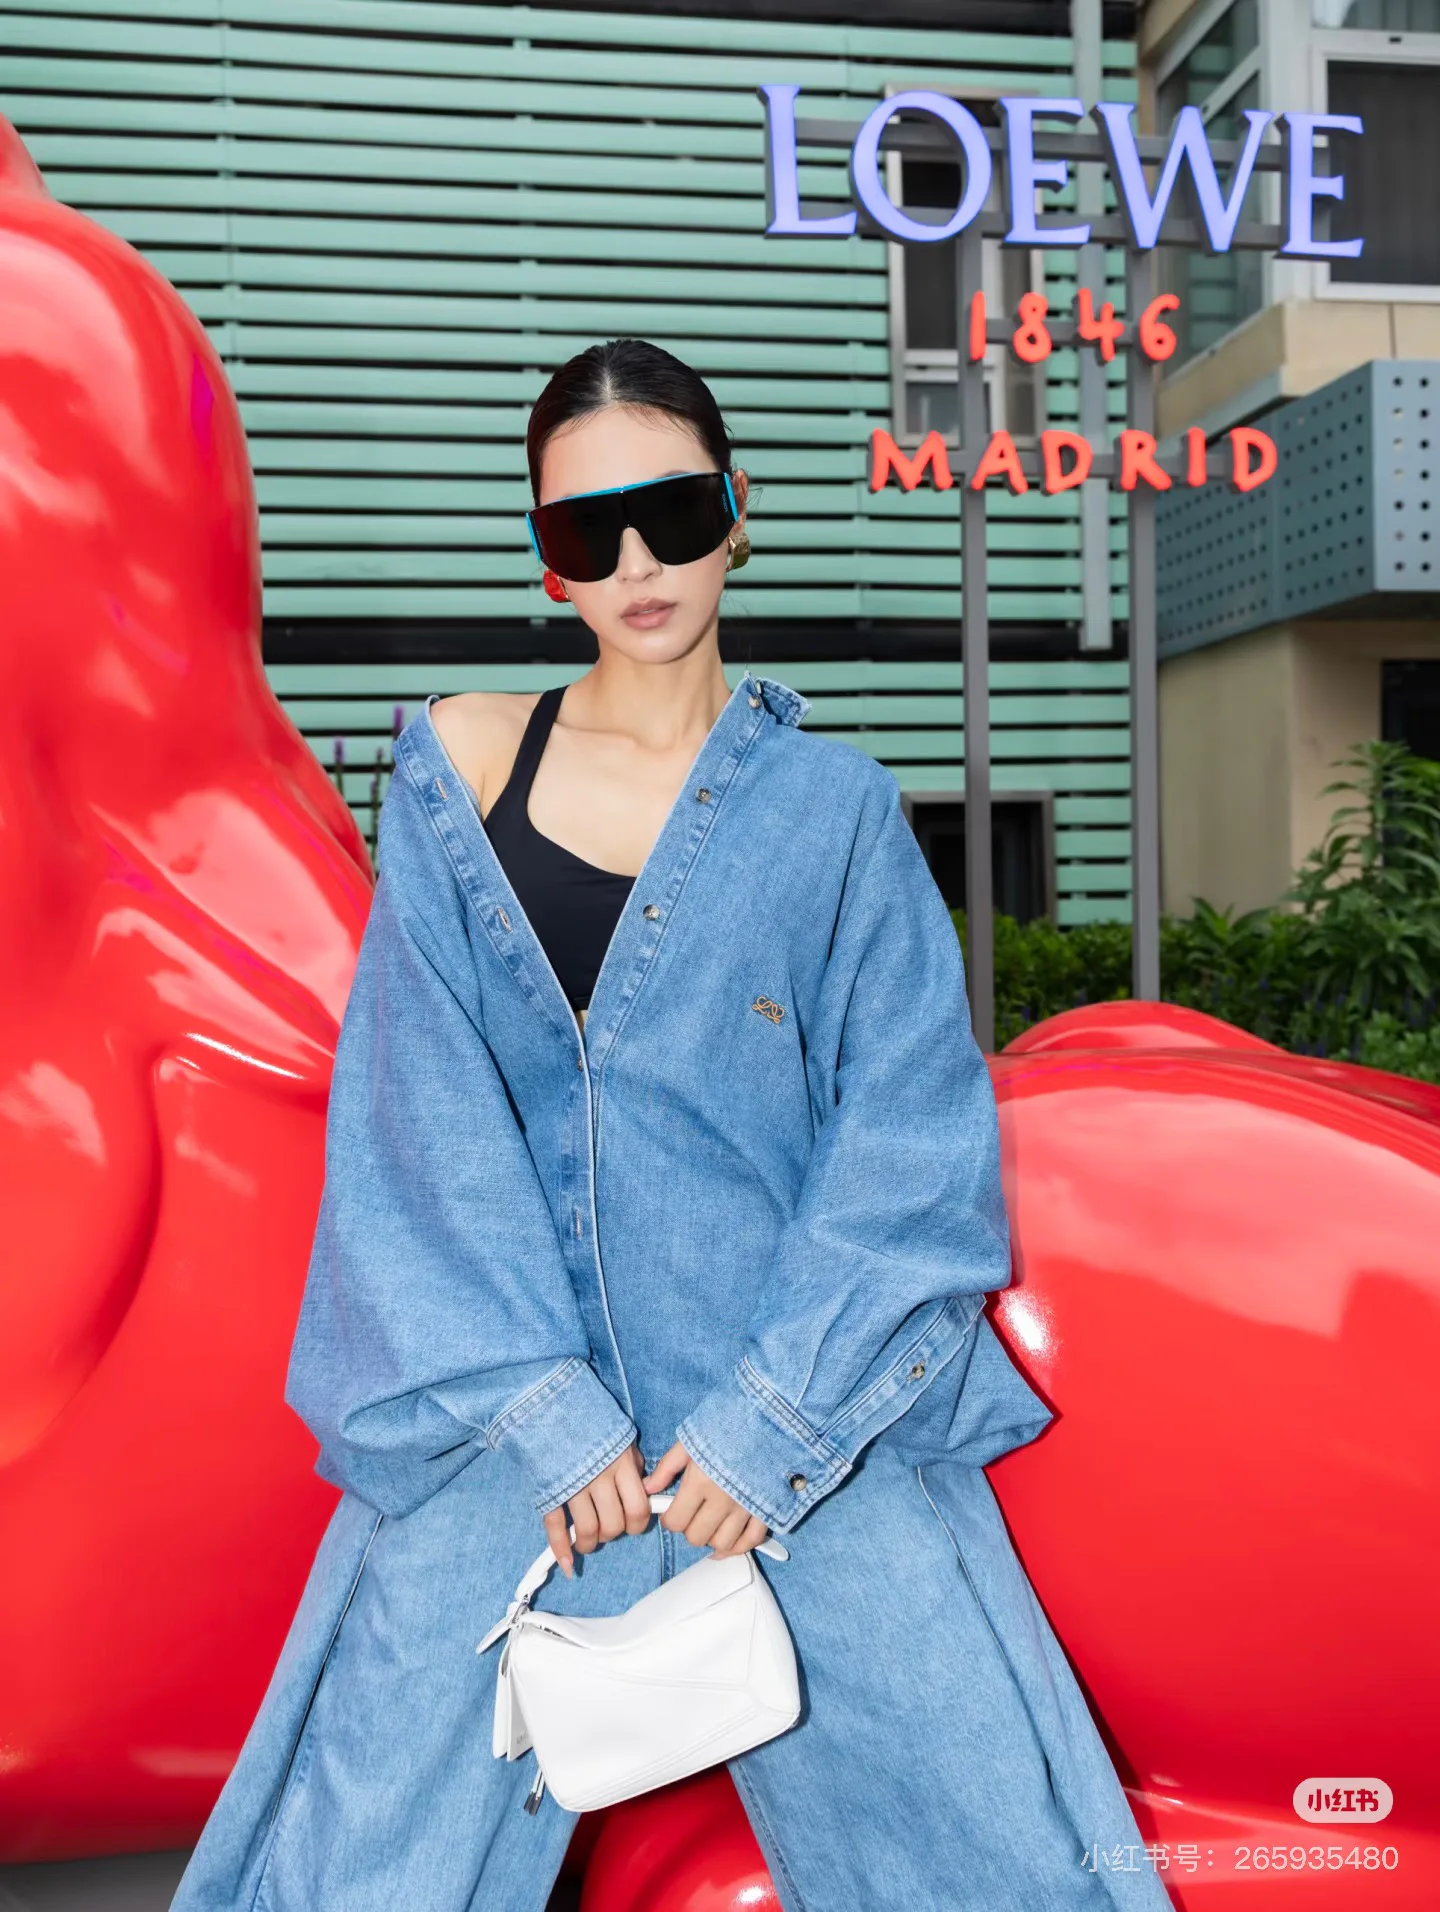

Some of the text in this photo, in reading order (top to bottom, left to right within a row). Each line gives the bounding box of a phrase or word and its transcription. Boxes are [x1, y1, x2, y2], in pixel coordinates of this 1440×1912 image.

[760, 84, 1364, 258] LOEWE
[969, 287, 1180, 363] 1846
[868, 427, 1278, 493] MADRID
